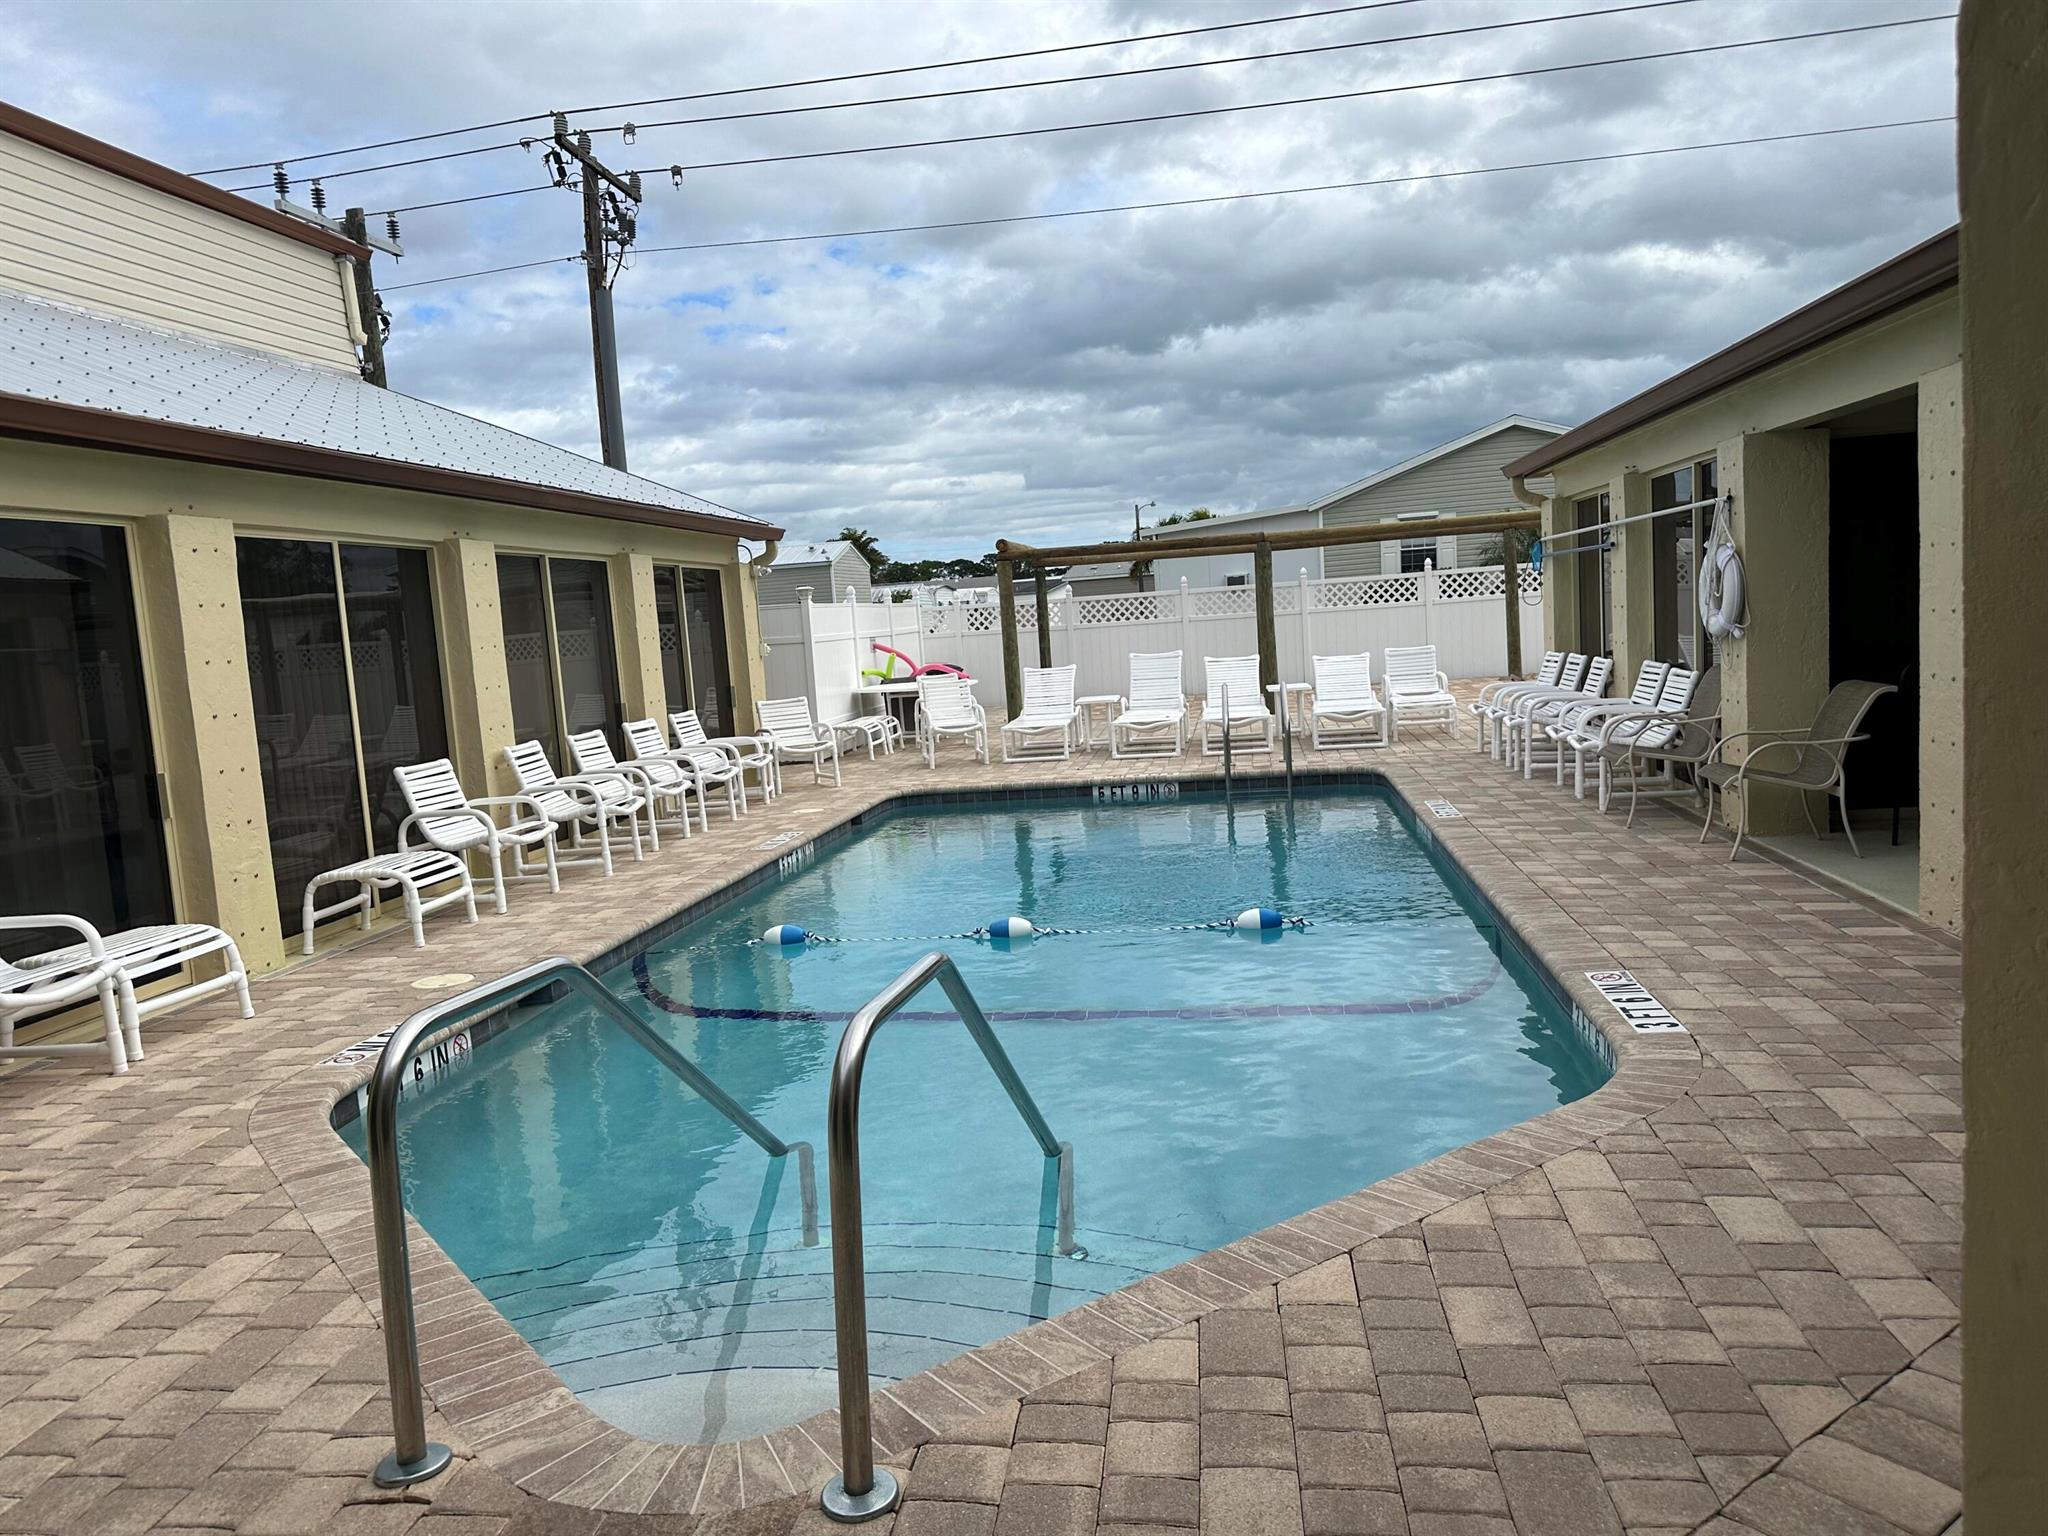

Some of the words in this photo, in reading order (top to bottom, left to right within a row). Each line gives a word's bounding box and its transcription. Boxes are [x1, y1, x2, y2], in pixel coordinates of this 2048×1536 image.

[1110, 785, 1126, 798] FT
[1598, 983, 1645, 994] IN
[1619, 1006, 1671, 1019] FT
[1635, 1021, 1680, 1029] 3
[413, 1056, 424, 1081] 6
[430, 1042, 449, 1072] IN
